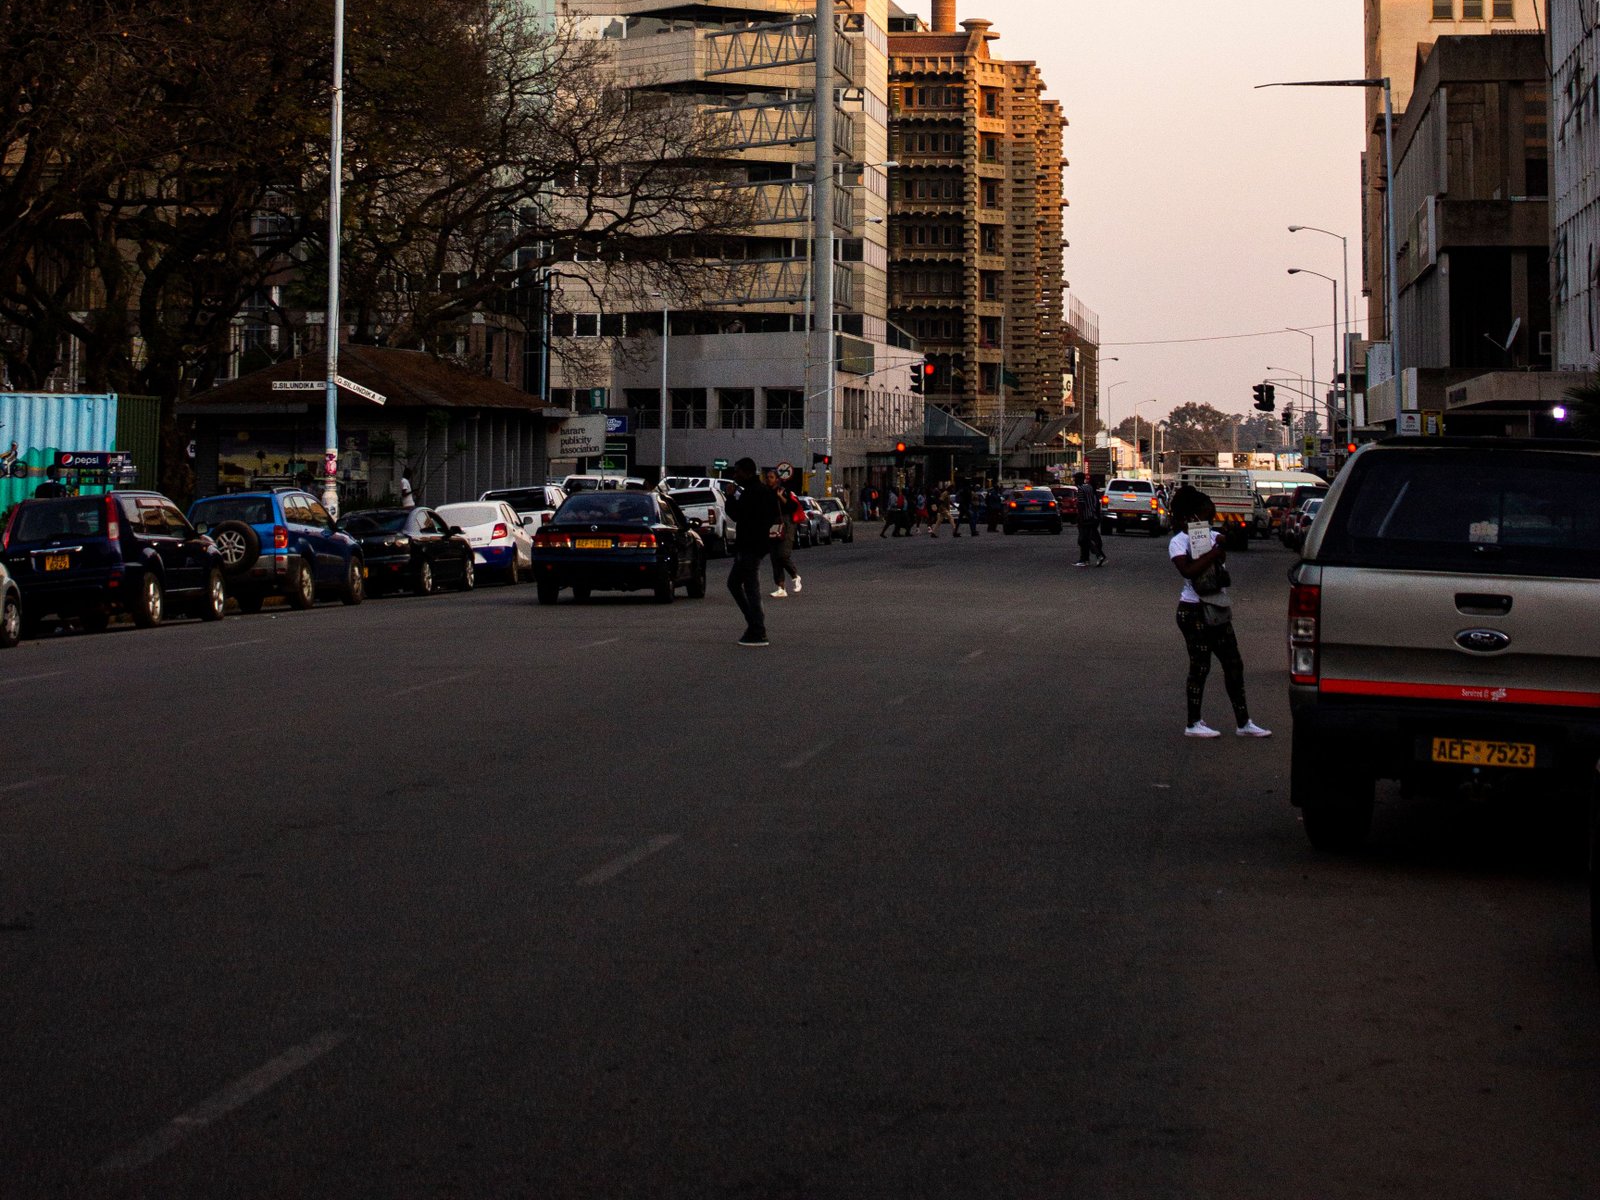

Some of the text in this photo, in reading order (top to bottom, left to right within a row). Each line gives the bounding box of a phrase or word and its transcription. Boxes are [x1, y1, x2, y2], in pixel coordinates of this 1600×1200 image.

[560, 426, 586, 436] harare
[560, 435, 592, 447] publicity
[560, 444, 600, 454] association
[74, 455, 99, 466] pepsi
[1437, 740, 1530, 765] AEF 7523
